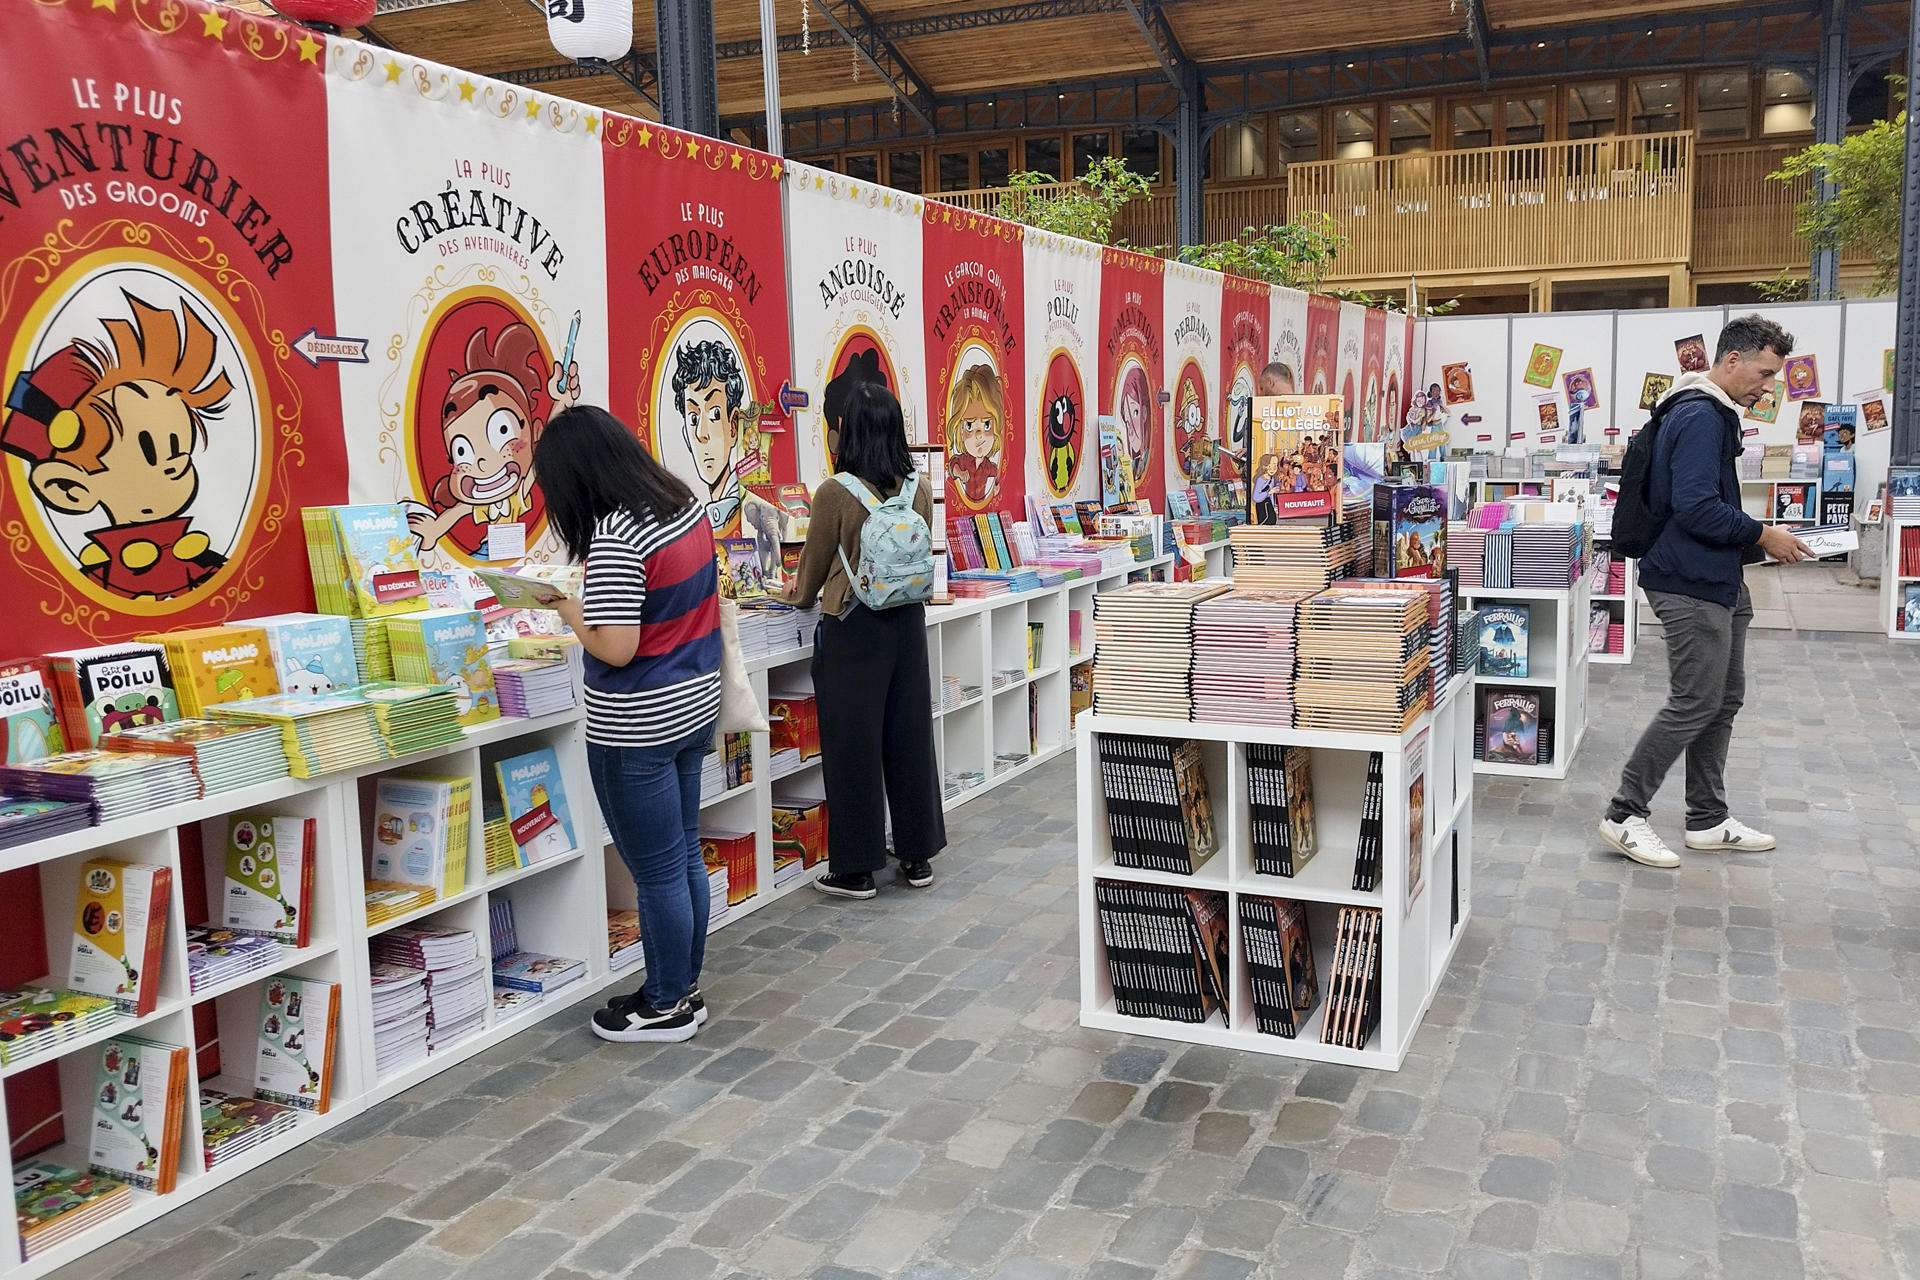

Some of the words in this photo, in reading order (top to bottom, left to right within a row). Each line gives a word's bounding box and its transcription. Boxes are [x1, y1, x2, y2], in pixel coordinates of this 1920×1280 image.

[72, 78, 101, 110] LE
[113, 82, 183, 125] PLUS
[455, 158, 472, 178] LA
[481, 162, 511, 189] PLUS
[0, 121, 293, 280] VENTURIER
[59, 182, 97, 210] DES
[106, 180, 209, 228] GROOMS
[680, 202, 693, 222] LE
[698, 202, 724, 228] PLUS
[396, 179, 564, 281] CRÉATIVE
[438, 238, 459, 257] DES
[845, 236, 856, 252] LE
[858, 235, 878, 258] PLUS
[637, 229, 763, 304] EUROPÉEN
[944, 270, 955, 288] LE
[955, 261, 984, 280] GARÇON
[987, 268, 1002, 290] QUI
[675, 266, 689, 286] DES
[692, 264, 733, 293] MANGAKA
[818, 258, 906, 320] ANGOISSÉ
[839, 291, 850, 308] DES
[1047, 296, 1080, 324] POILU
[933, 280, 1017, 356] TRANSFORME
[1174, 315, 1212, 347] PERDANT
[307, 341, 359, 356] DÉDICACES
[1262, 406, 1302, 418] ELLIOT
[1305, 406, 1321, 416] AU
[1261, 417, 1322, 431] COLLÈGE
[1284, 498, 1325, 509] NOUVEAUTÉ
[1827, 503, 1850, 513] PETIT
[353, 516, 398, 531] MOLANG
[1827, 513, 1849, 524] PAYS
[378, 584, 390, 592] EN
[391, 579, 417, 591] DÉDICACE
[425, 576, 447, 591] élie
[292, 632, 342, 651] MOLANG
[434, 625, 476, 642] MOLANG
[202, 644, 258, 664] MOLANG
[96, 670, 154, 691] POILU
[101, 665, 121, 677] Petit
[0, 684, 41, 706] OILU
[511, 760, 551, 781] MOLANG
[517, 811, 547, 835] NOUVEAUTÉ
